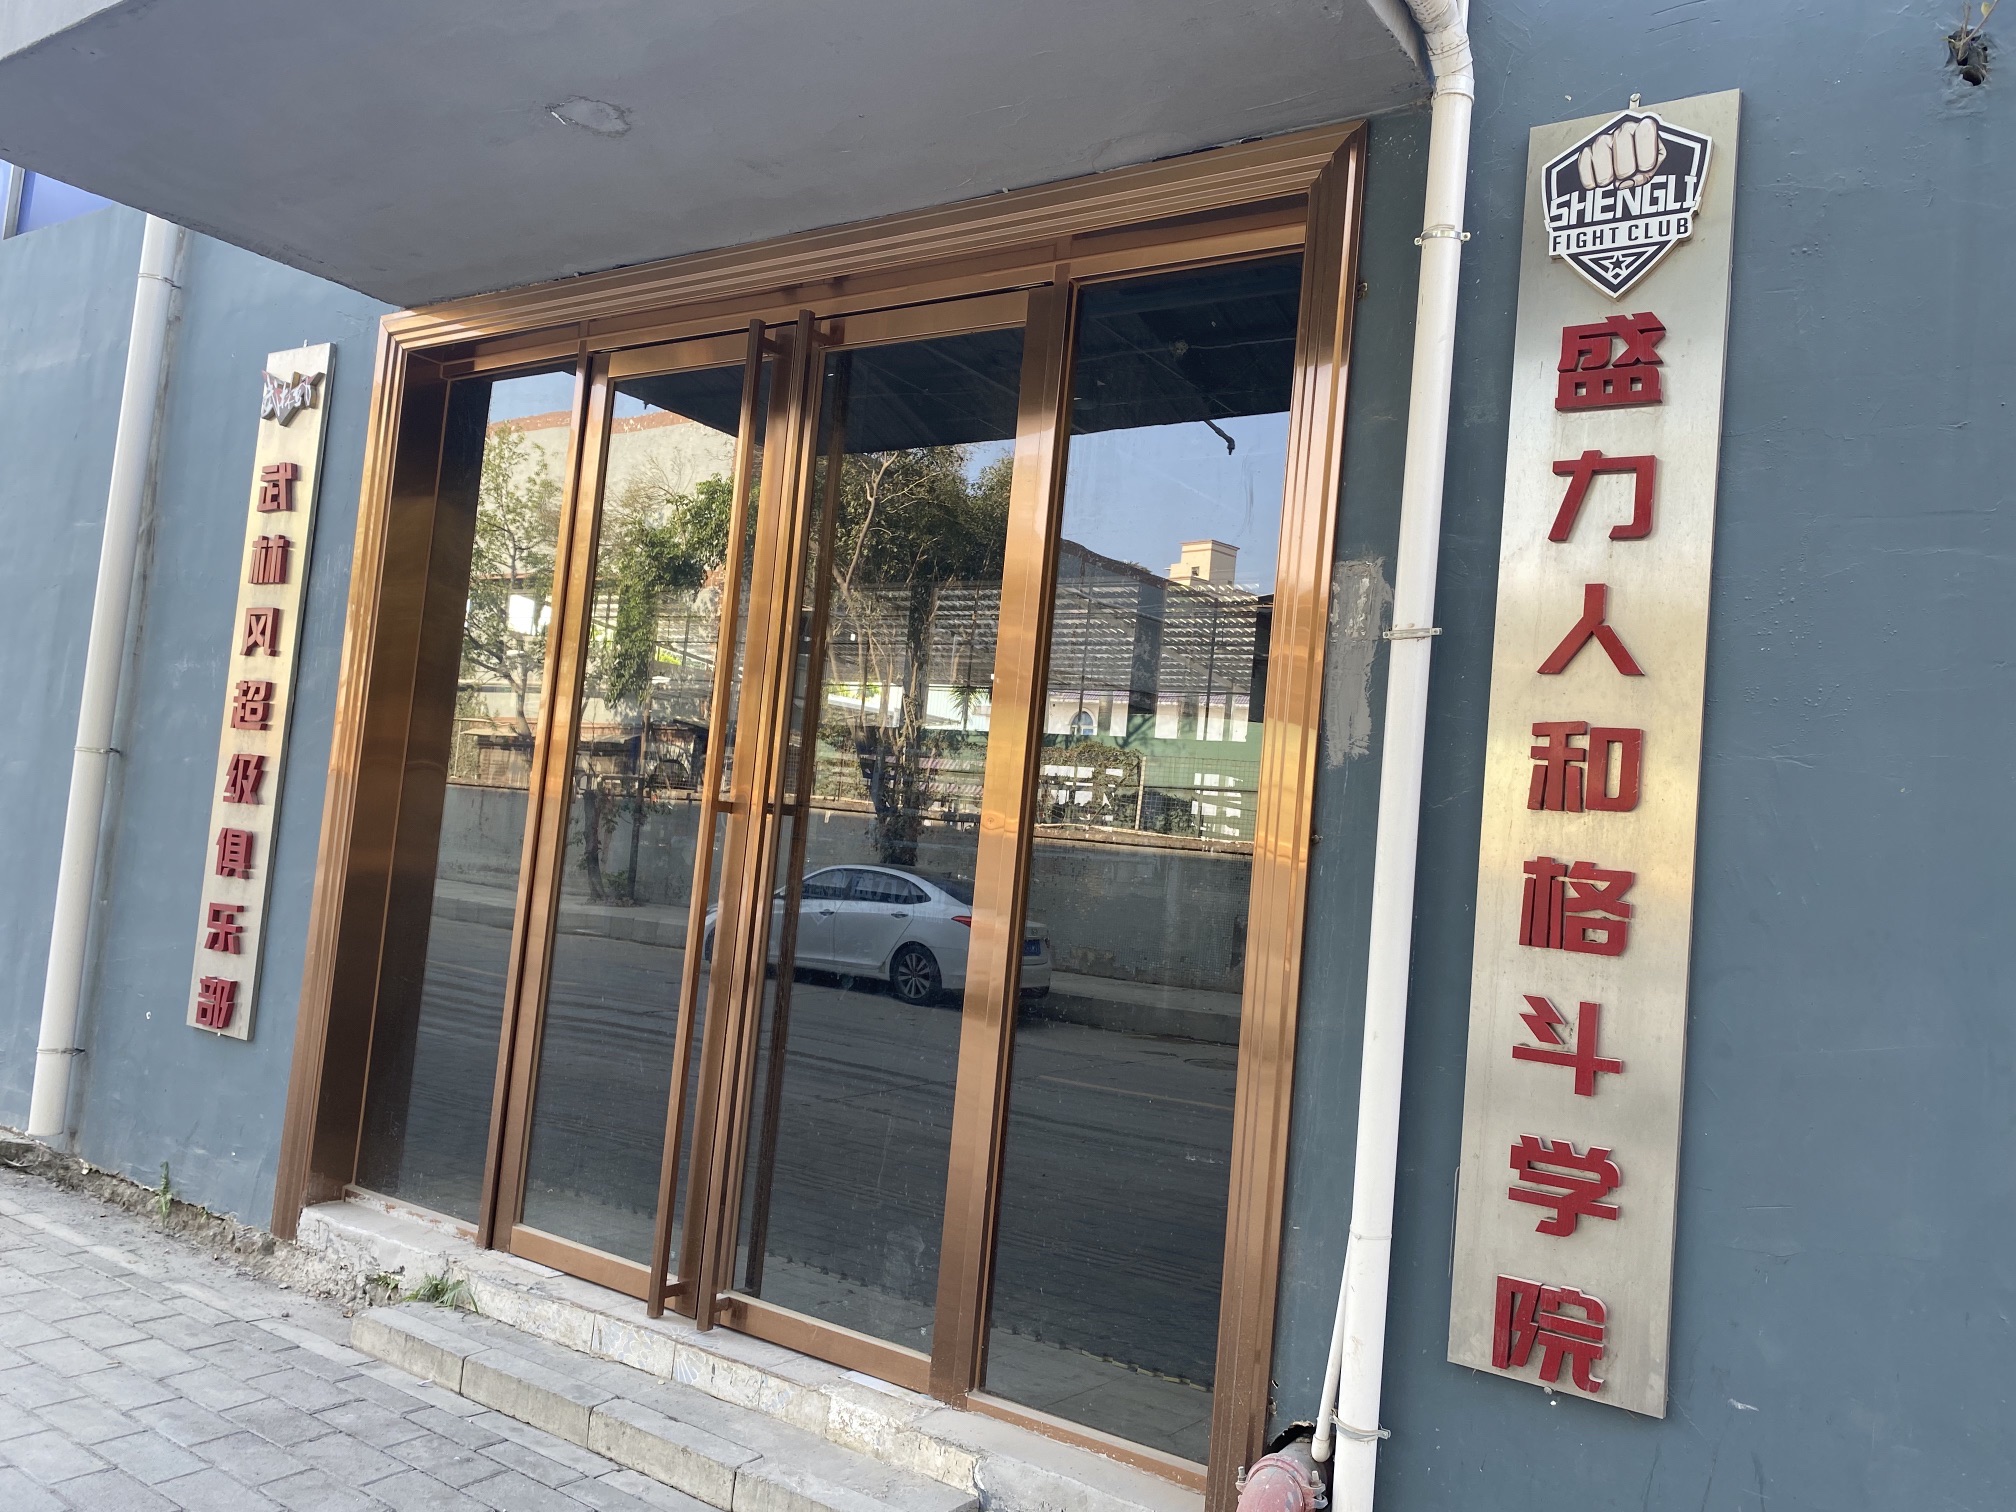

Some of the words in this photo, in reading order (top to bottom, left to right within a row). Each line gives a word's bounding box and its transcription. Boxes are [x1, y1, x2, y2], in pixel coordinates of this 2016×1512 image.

[1549, 175, 1697, 227] SHENGLI
[1552, 227, 1619, 252] FIGHT
[1627, 217, 1688, 242] CLUB
[195, 462, 298, 1029] 武林风超级俱乐部
[1494, 312, 1665, 1393] 盛力人和格斗学院
